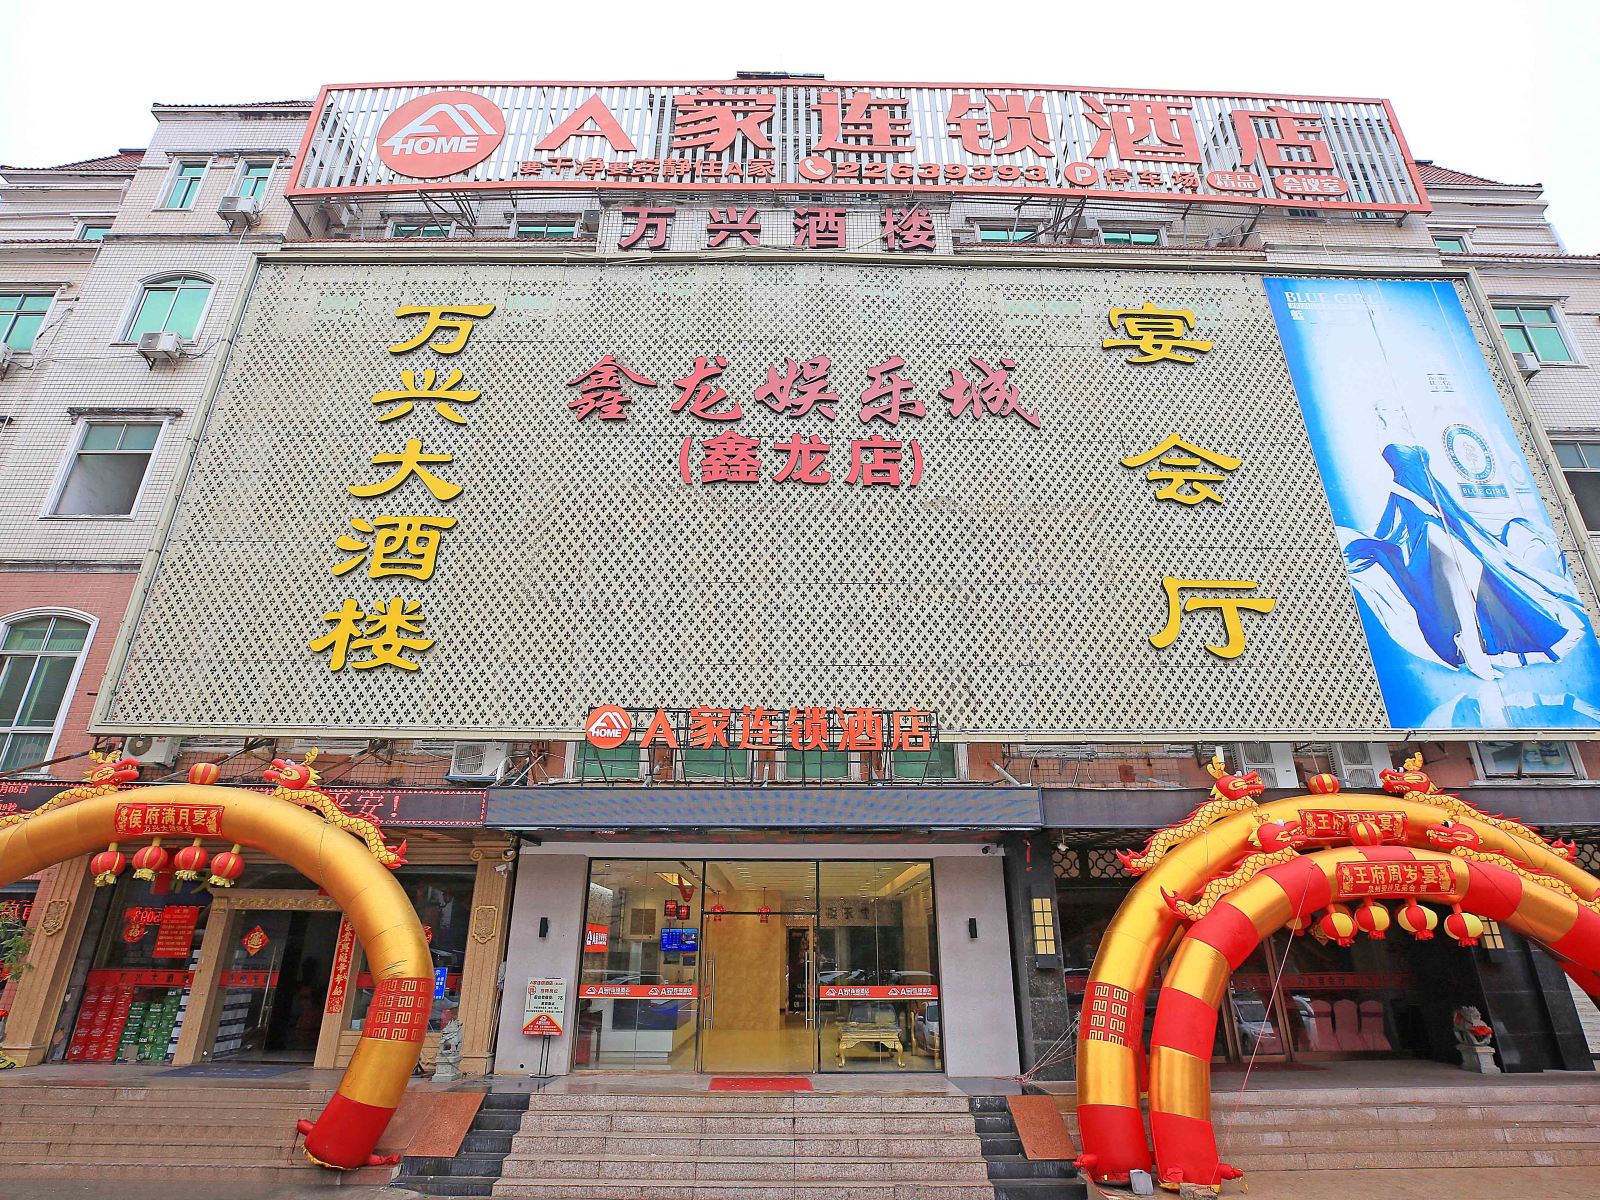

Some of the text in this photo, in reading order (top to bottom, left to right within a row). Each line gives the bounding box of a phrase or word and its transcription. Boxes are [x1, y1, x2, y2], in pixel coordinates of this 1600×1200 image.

[533, 86, 1336, 170] A家连锁酒店
[391, 135, 480, 157] HOME
[834, 161, 1047, 182] 22639393
[1103, 167, 1201, 191] 停车场
[1283, 176, 1342, 193] 会议室
[617, 206, 936, 250] 万兴酒楼
[1284, 291, 1329, 303] BLUE
[567, 354, 1042, 430] 鑫龙娱乐城
[680, 431, 924, 487] (鑫龙店)
[309, 303, 497, 672] 万兴大酒楼
[1101, 302, 1277, 660] 宴会厅
[1462, 486, 1507, 495] BLUE GIRL
[591, 728, 622, 738] HOME
[639, 704, 931, 752] A家连锁酒店
[128, 806, 208, 829] 侯府满月宴
[1353, 864, 1439, 885] 王府周岁宴
